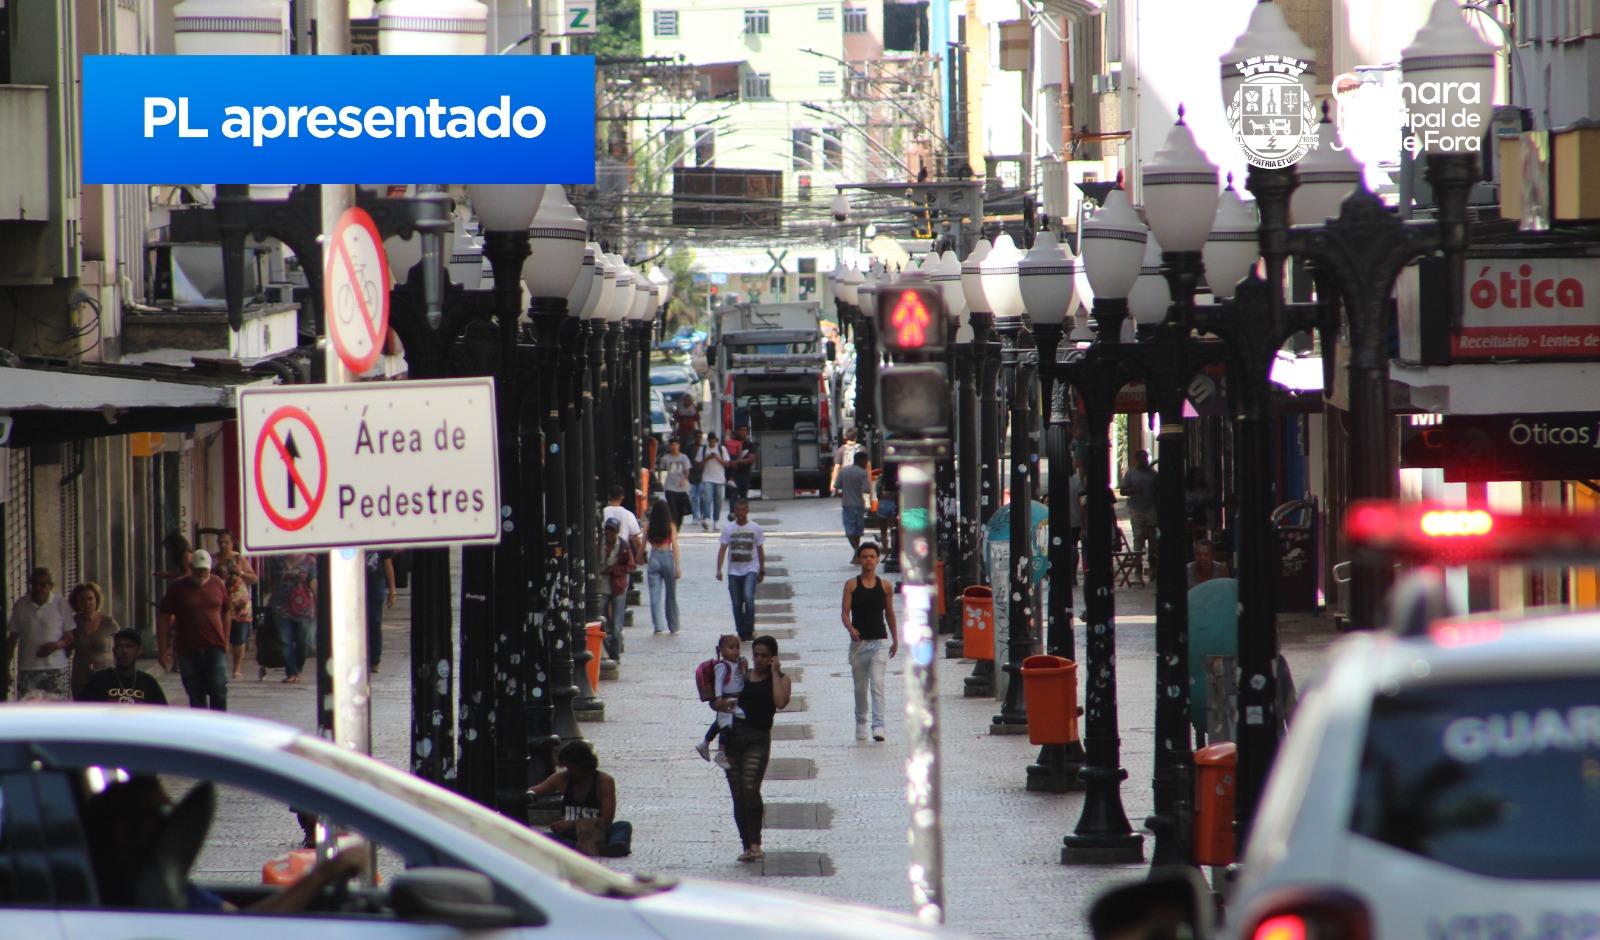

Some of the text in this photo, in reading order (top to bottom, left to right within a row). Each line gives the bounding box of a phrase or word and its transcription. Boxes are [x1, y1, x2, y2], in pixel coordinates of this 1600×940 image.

[569, 8, 589, 28] Z
[1470, 263, 1584, 309] ótica
[1460, 333, 1529, 349] Receituário
[1540, 334, 1580, 348] Lentes
[355, 404, 466, 455] Área de
[1509, 418, 1590, 445] Óticas
[338, 483, 484, 519] Pedestres
[108, 687, 145, 699] GUCCI
